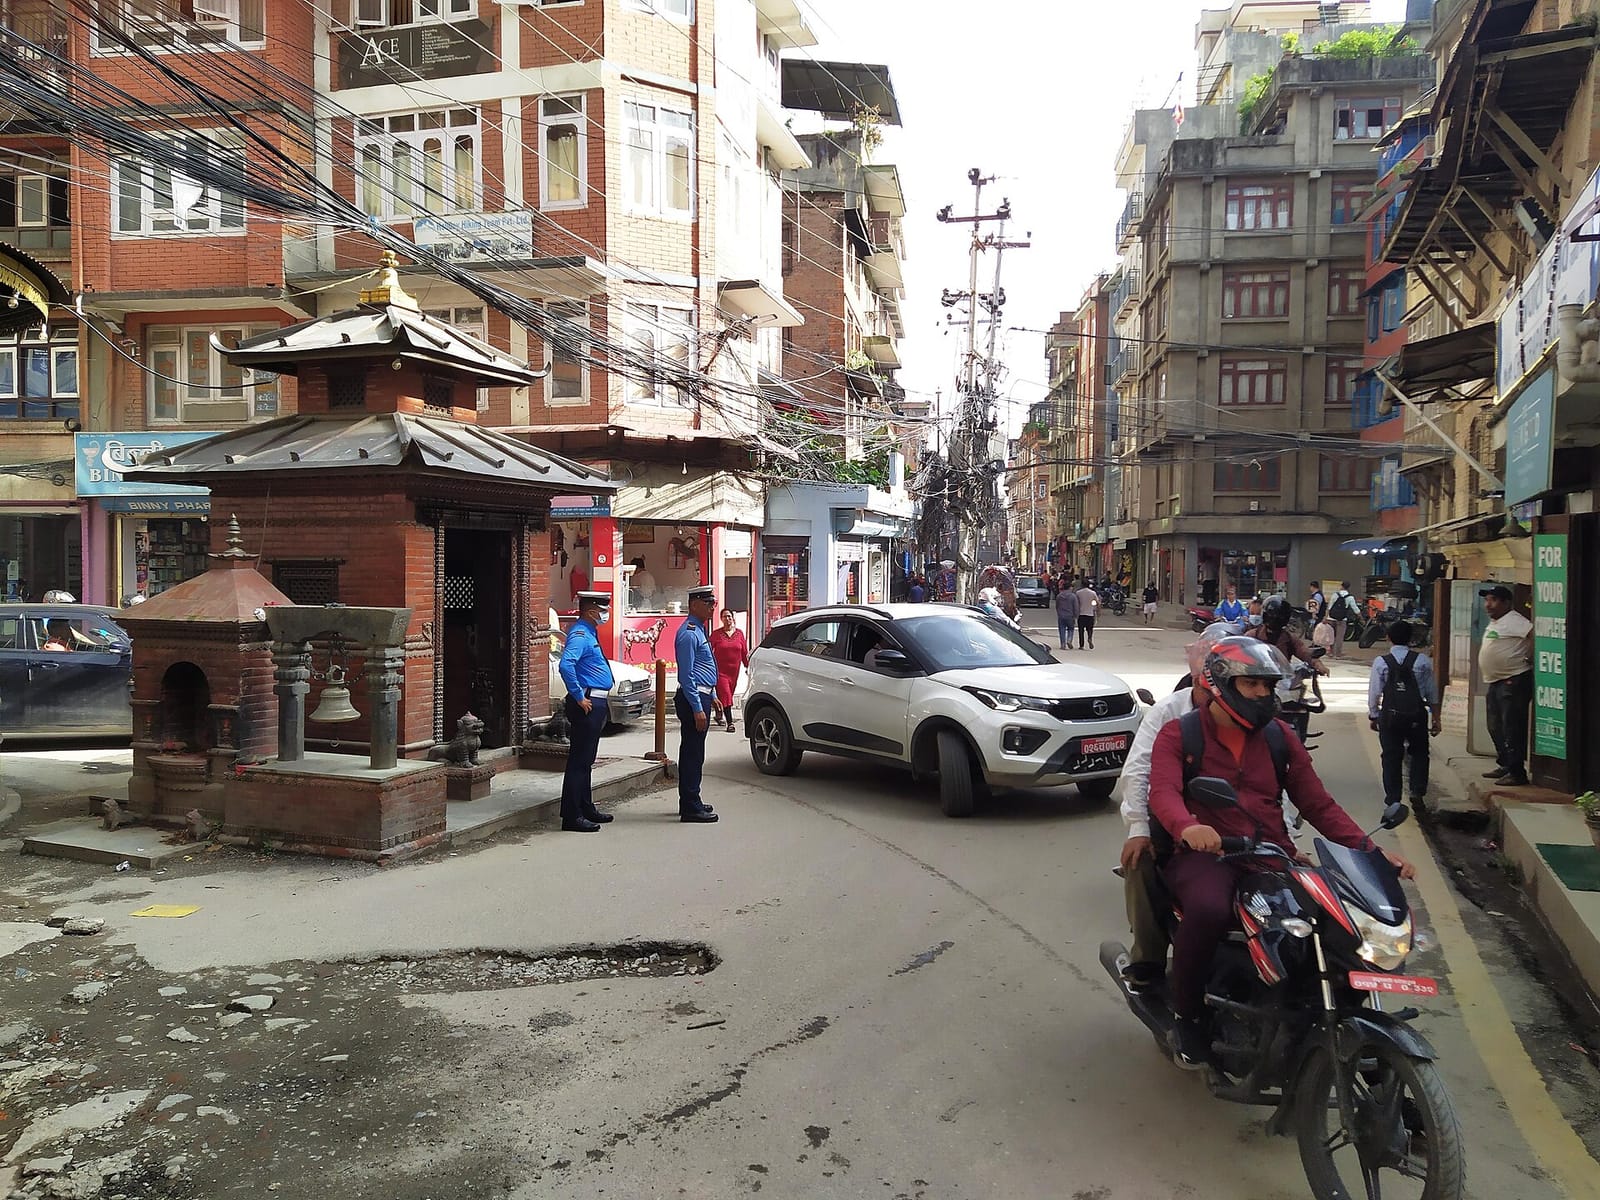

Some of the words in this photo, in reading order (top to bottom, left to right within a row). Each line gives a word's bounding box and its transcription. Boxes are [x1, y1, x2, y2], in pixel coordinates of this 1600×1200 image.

[360, 37, 399, 66] ACE
[128, 502, 168, 510] BINNY
[174, 502, 211, 510] PHAR
[1538, 546, 1562, 568] FOR
[1537, 581, 1563, 603] YOUR
[1539, 651, 1562, 674] EYE
[1537, 686, 1564, 709] CARE
